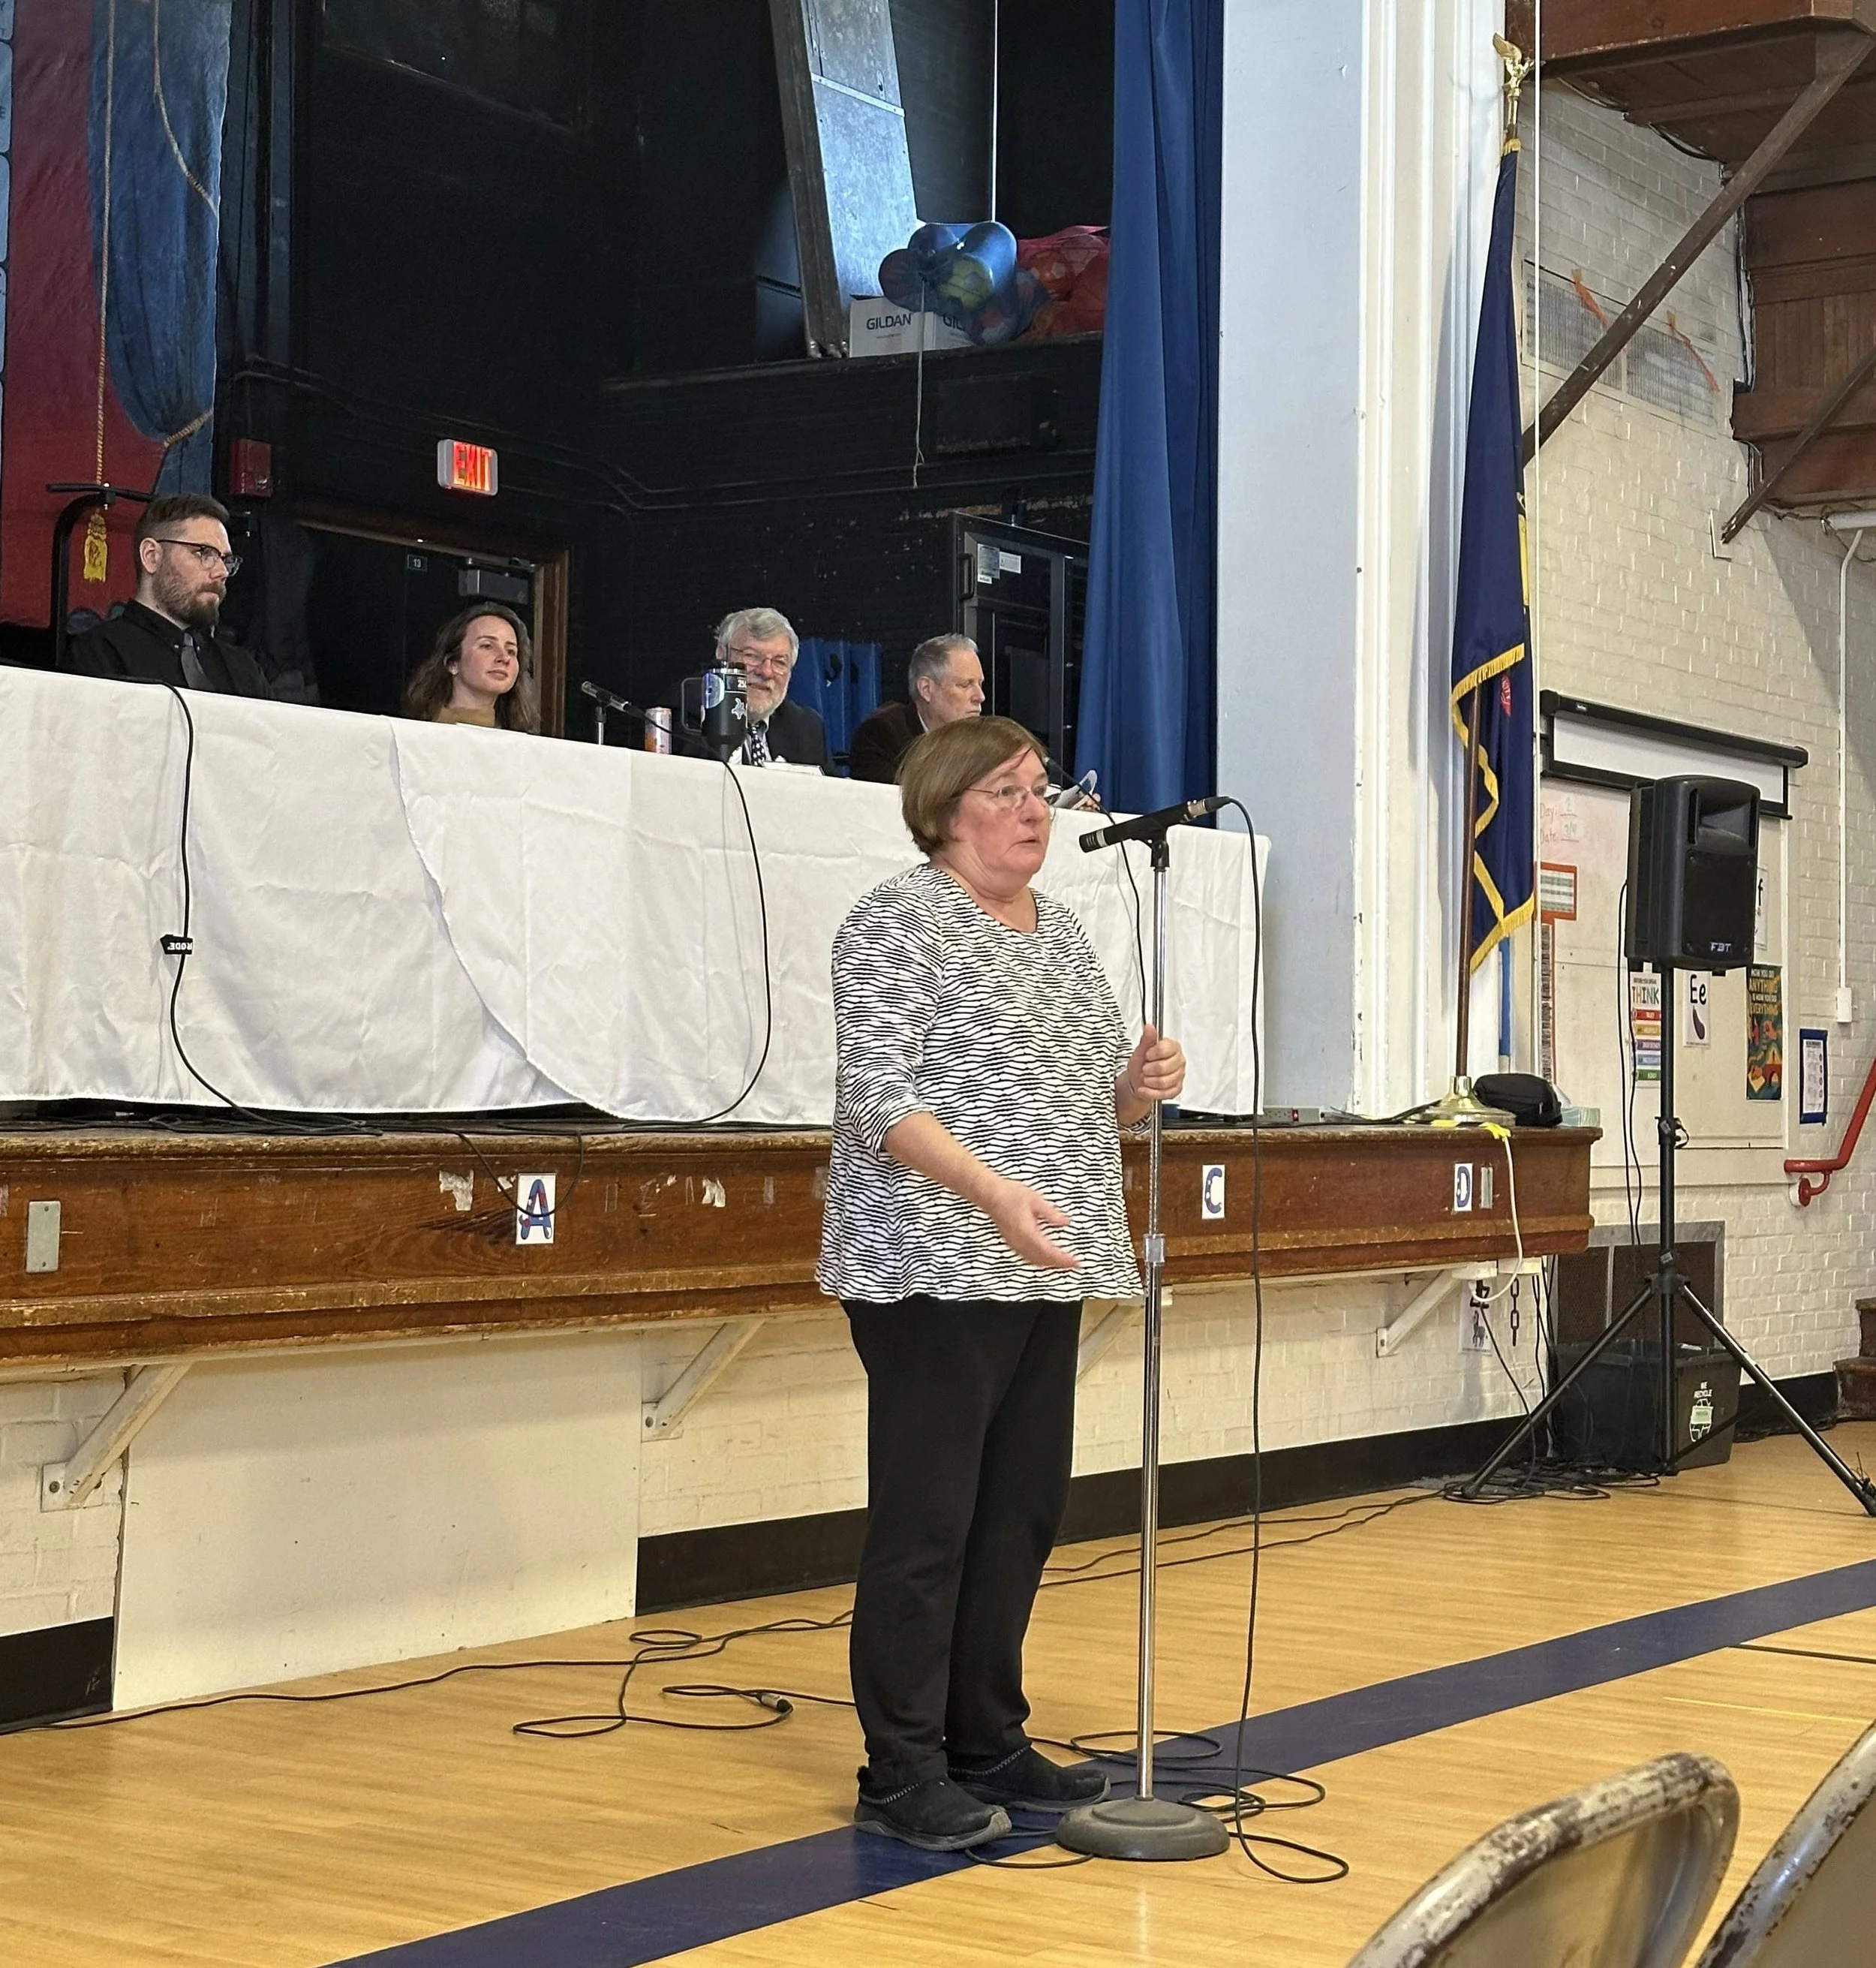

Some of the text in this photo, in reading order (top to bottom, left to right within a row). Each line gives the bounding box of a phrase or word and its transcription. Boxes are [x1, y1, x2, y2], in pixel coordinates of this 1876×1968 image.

[867, 313, 911, 330] GILDAN
[453, 442, 492, 491] EXIT
[413, 558, 422, 568] 13
[1710, 942, 1732, 952] FBT
[1631, 986, 1660, 1004] THINK
[1690, 973, 1707, 1006] Ee
[1204, 1167, 1222, 1214] C
[1456, 1166, 1471, 1208] D
[519, 1179, 552, 1240] A
